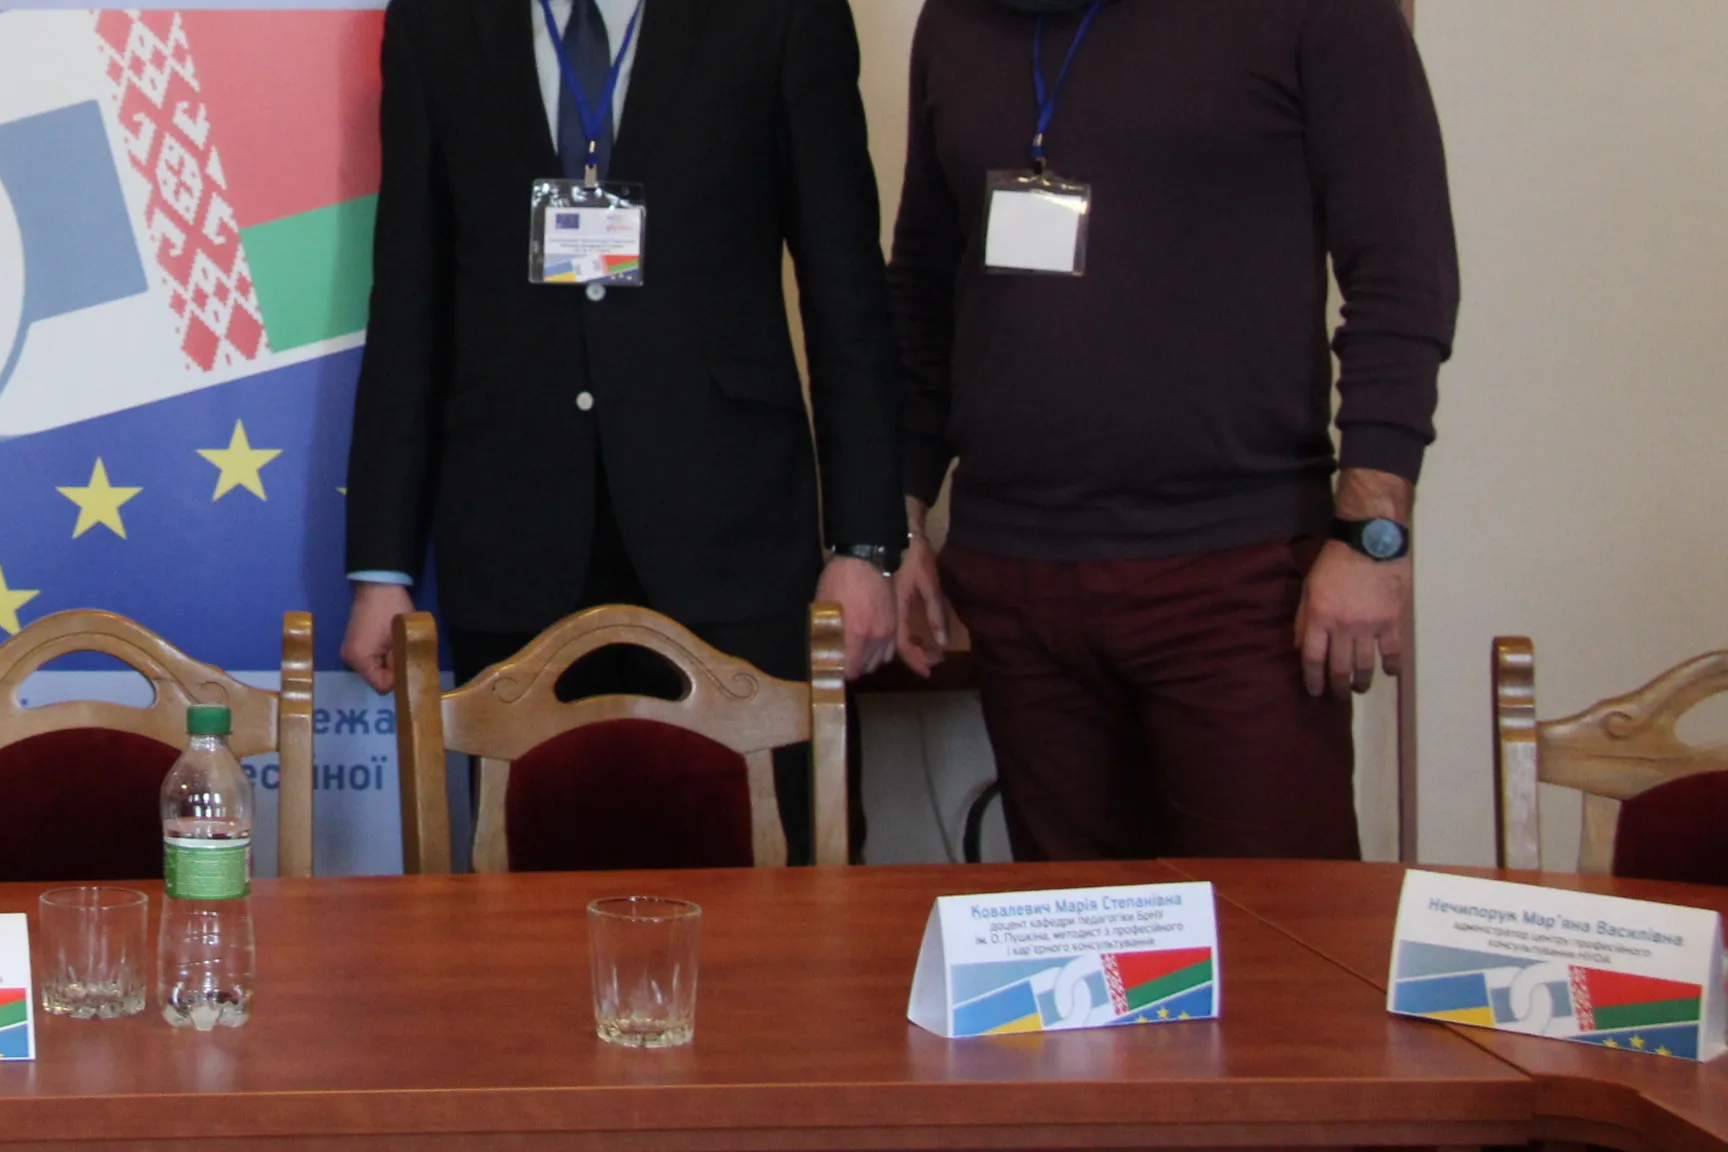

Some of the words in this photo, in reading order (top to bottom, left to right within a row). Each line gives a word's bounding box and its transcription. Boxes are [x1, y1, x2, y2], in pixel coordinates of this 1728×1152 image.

[1055, 898, 1098, 915] Марія
[1102, 894, 1182, 910] Степанівна
[1428, 898, 1518, 924] Нечипорук
